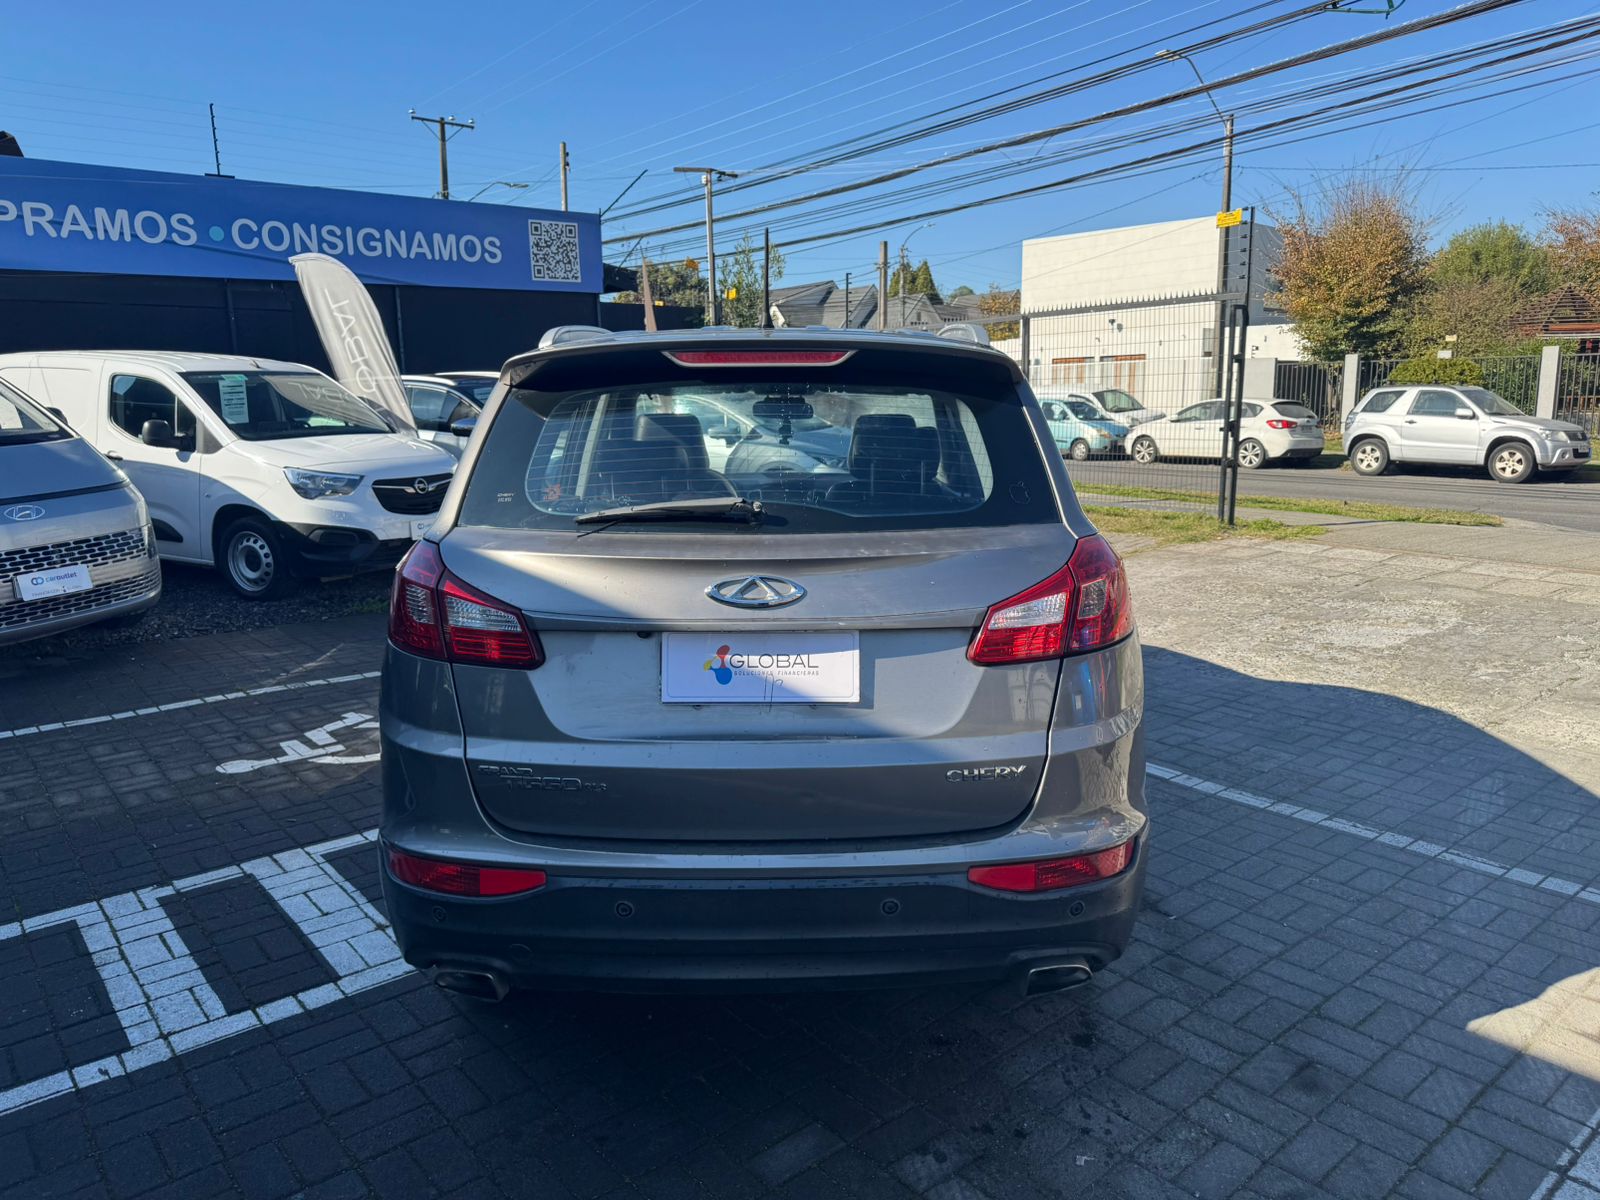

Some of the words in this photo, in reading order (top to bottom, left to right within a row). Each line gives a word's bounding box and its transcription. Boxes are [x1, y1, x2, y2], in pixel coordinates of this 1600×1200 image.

[231, 218, 502, 264] CONSIGNAMOS
[729, 653, 819, 669] GLOBAL
[945, 765, 1026, 782] CHERY
